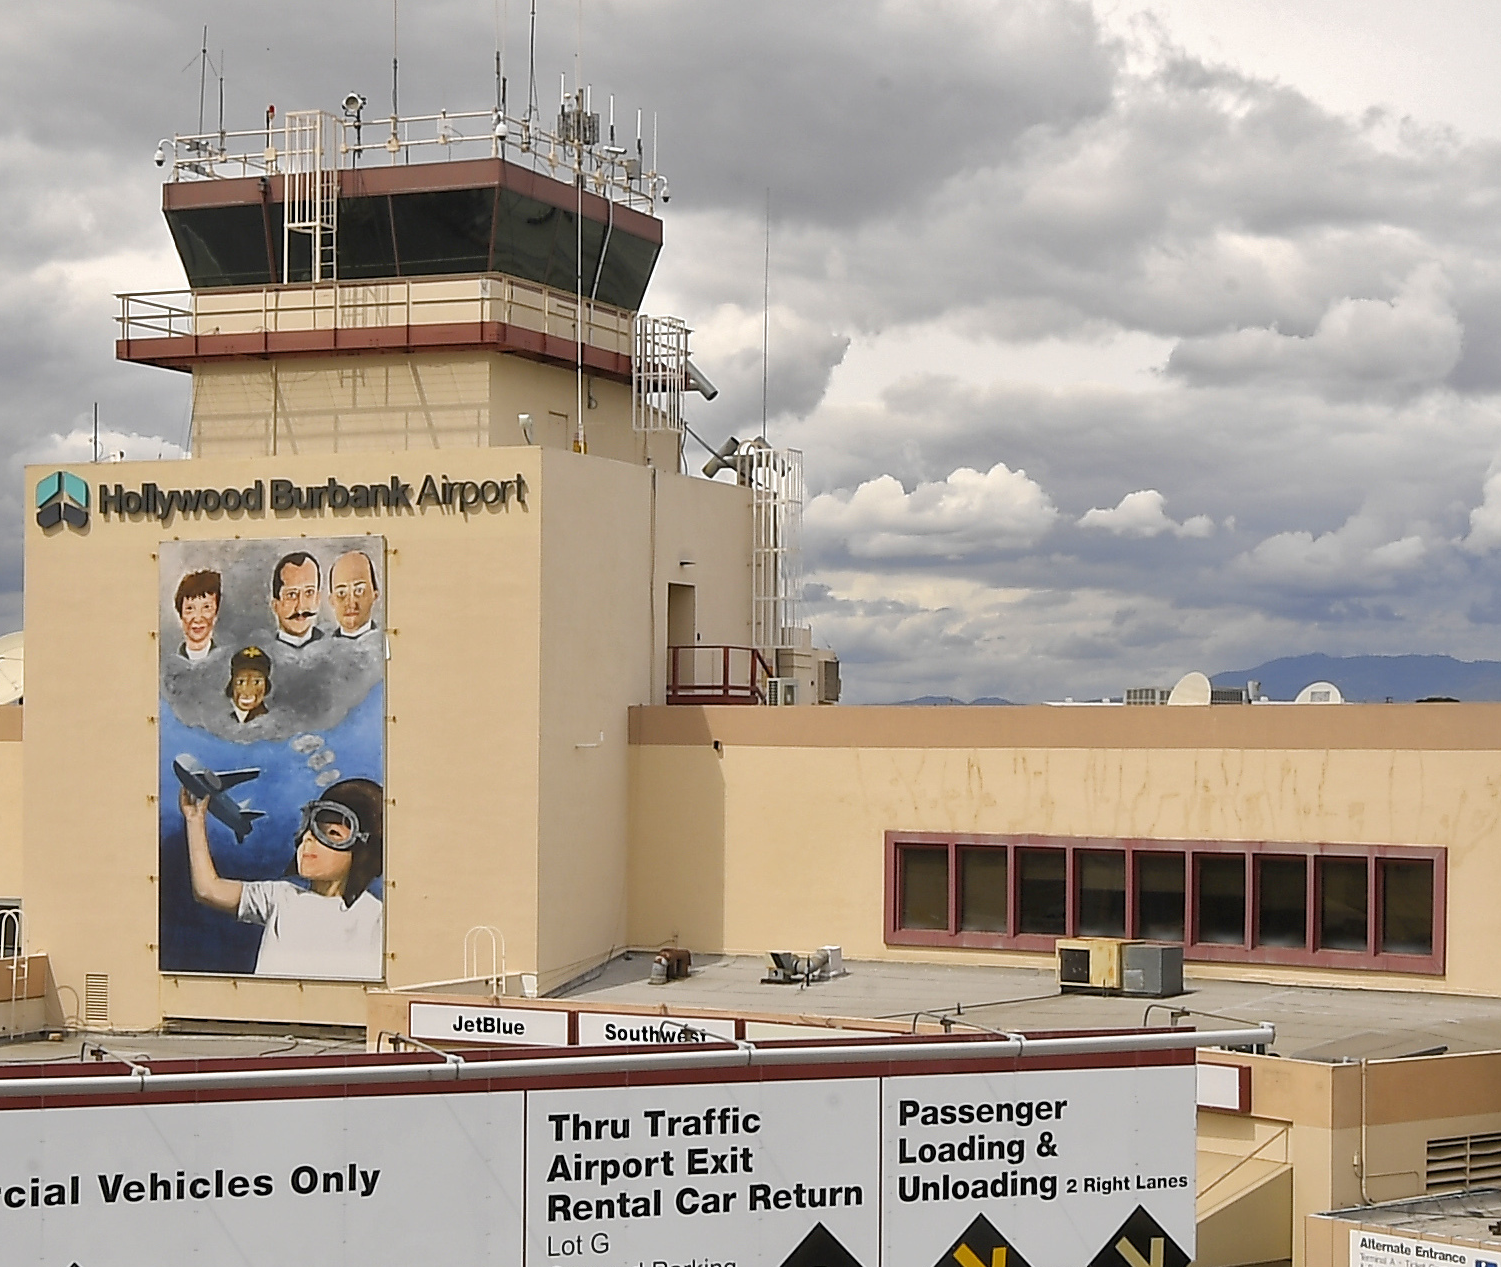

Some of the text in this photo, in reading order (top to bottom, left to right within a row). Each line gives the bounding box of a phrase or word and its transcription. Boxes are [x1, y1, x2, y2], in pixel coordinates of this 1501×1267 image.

[99, 473, 524, 520] Hollywood Burbank Airport
[453, 1016, 524, 1035] JetBlue
[549, 1108, 760, 1141] Thru Traffic
[899, 1099, 1068, 1129] Passenger
[547, 1145, 753, 1187] Airport Exit
[898, 1132, 1057, 1168] Loading &
[98, 1170, 272, 1202] Vehicles
[291, 1164, 380, 1196] Only
[898, 1171, 1187, 1206] Unloading 2 Right Lanes
[547, 1184, 862, 1222] Rental Car Return
[547, 1233, 608, 1257] Lot G
[1360, 1237, 1466, 1264] Alternate Entrance
[1360, 1253, 1387, 1265] Terminal
